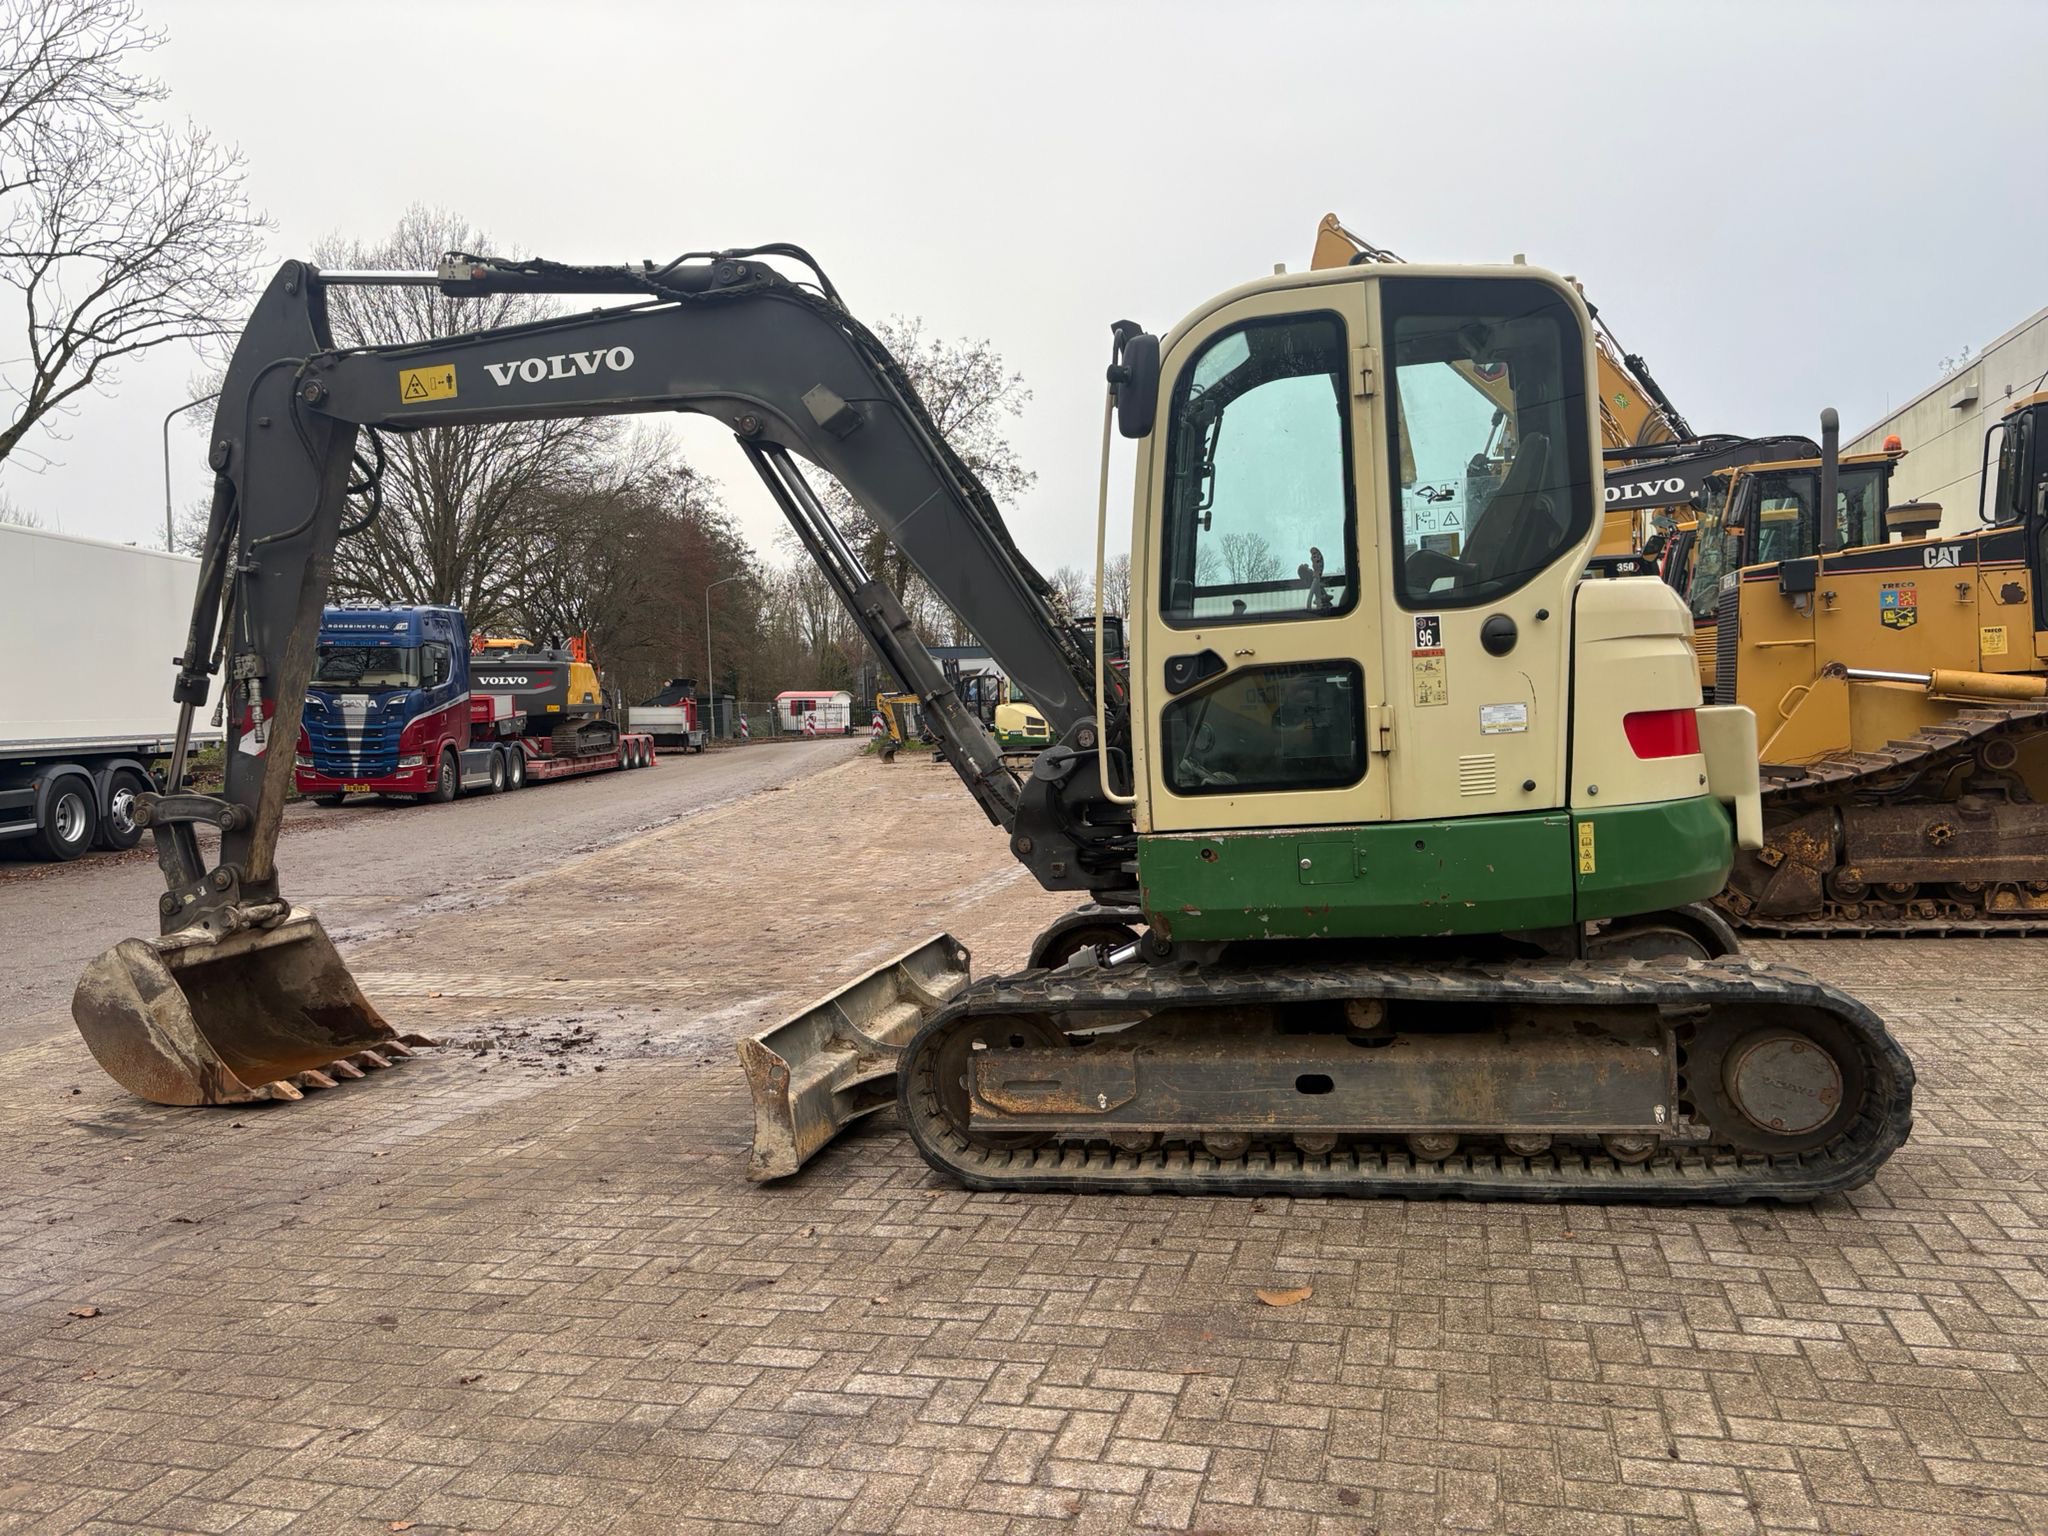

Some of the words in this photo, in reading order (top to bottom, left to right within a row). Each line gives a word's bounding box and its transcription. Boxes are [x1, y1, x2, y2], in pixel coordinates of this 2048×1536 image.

[483, 346, 634, 386] VOLVO
[1604, 478, 1685, 502] OLVO
[1923, 546, 1963, 568] CAT
[1419, 629, 1432, 646] 96
[478, 676, 528, 685] VOLVO
[333, 699, 377, 708] SCANIA
